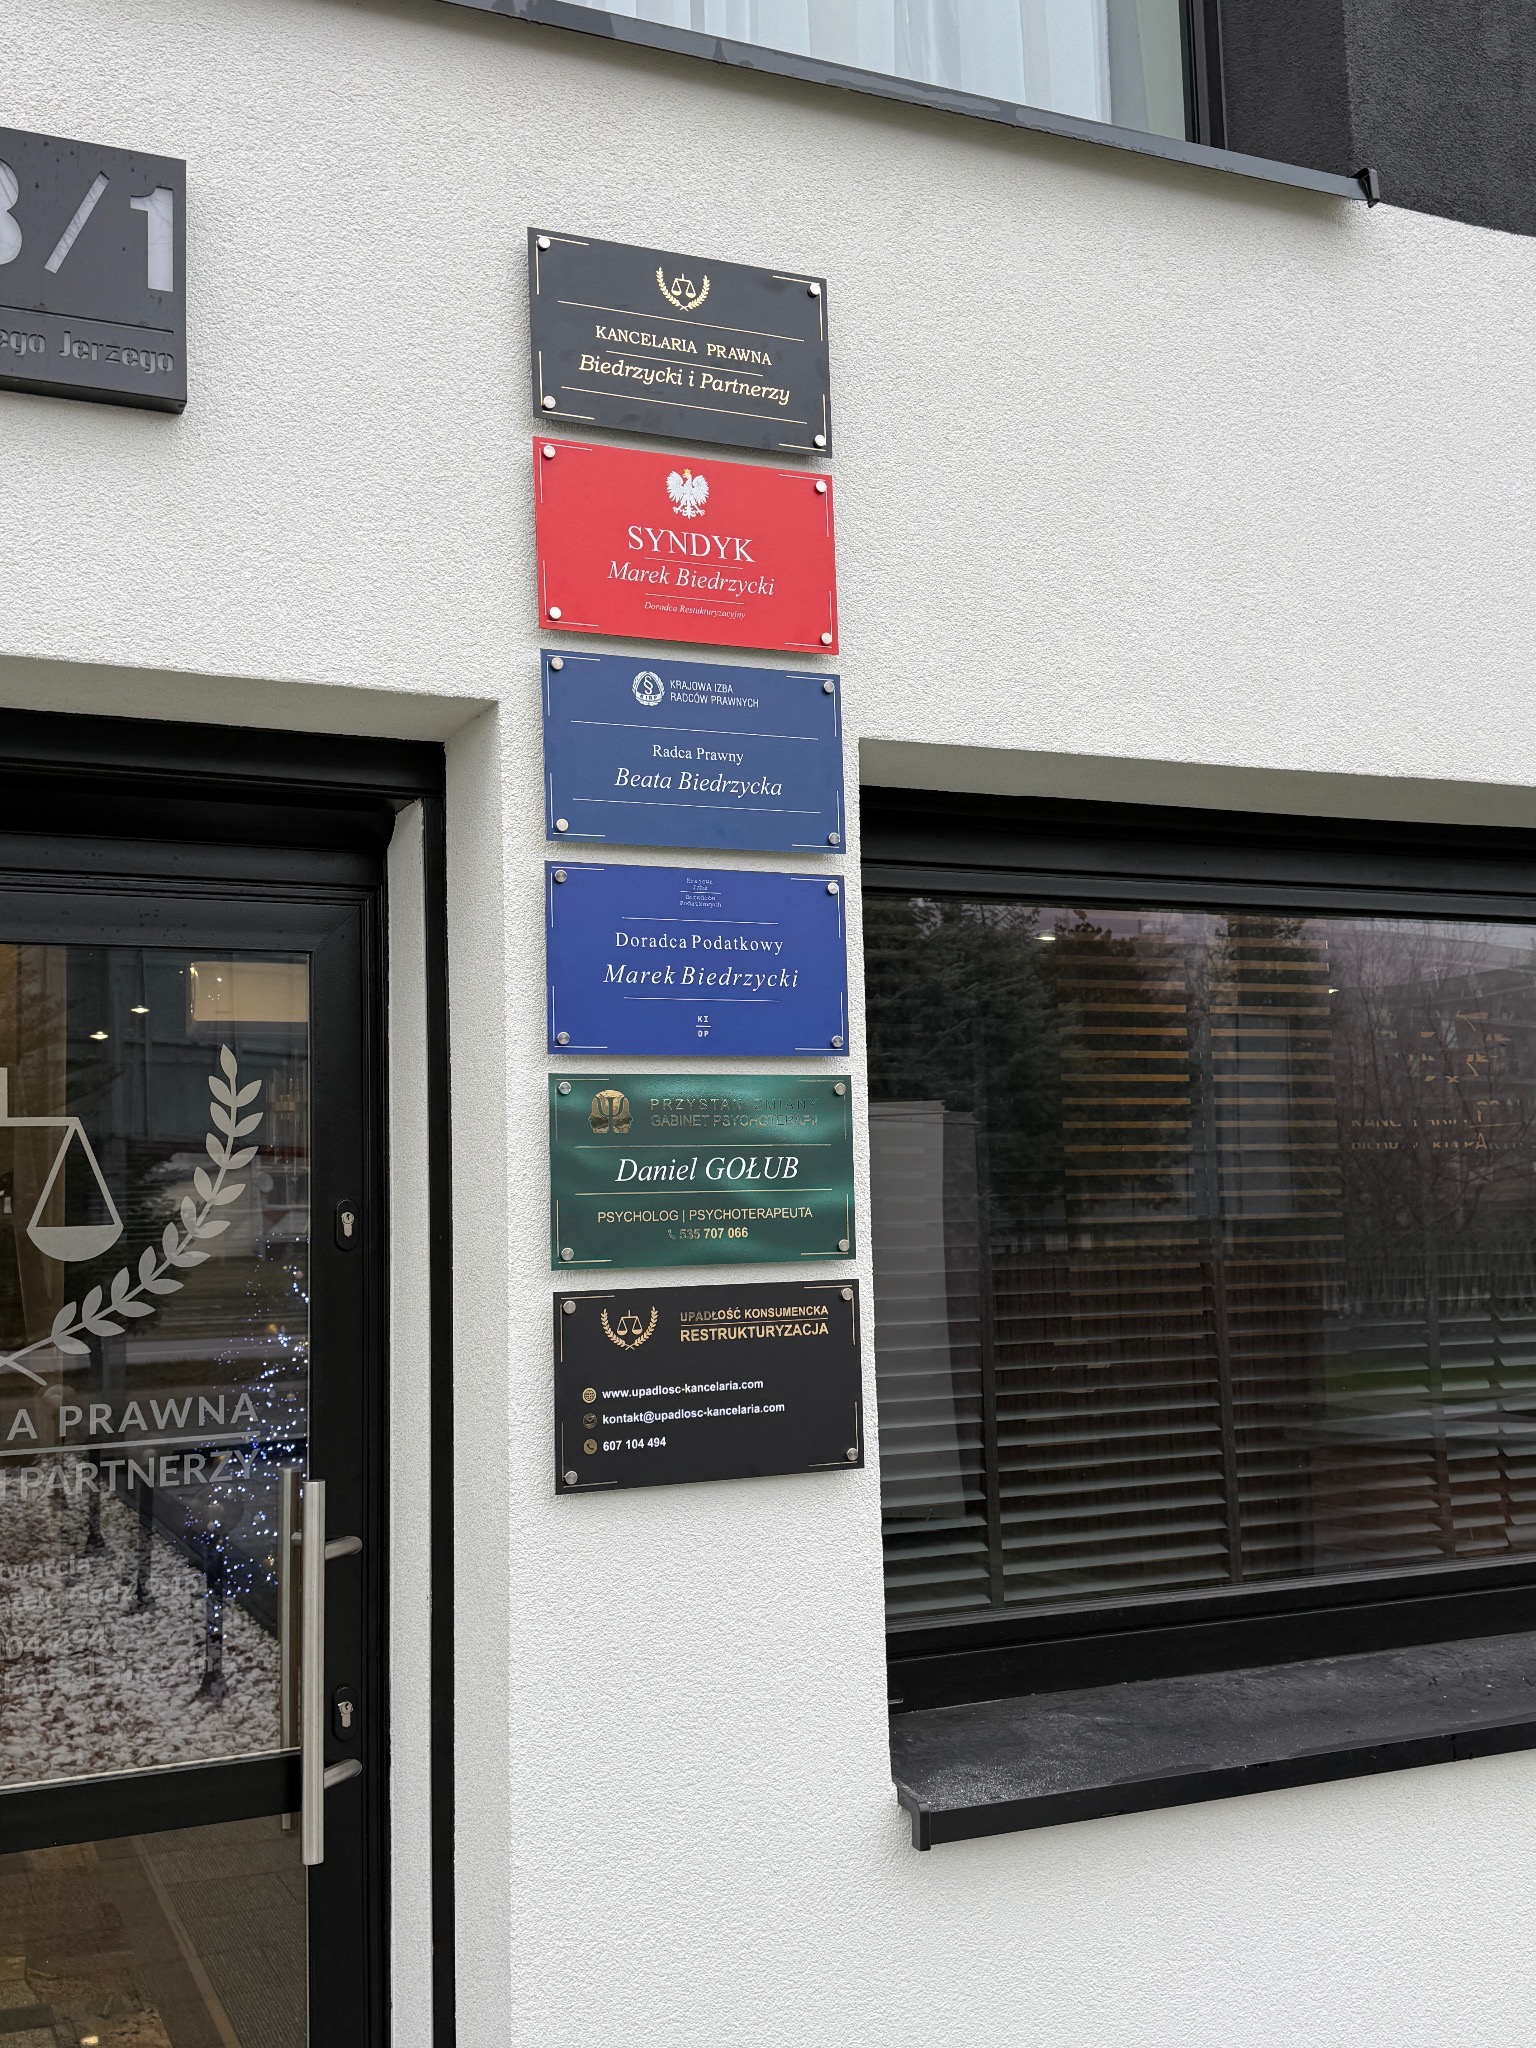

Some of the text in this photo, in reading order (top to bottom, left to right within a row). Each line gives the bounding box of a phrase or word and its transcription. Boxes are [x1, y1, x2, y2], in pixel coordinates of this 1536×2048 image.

[59, 331, 174, 374] Jerzego
[595, 325, 772, 366] KANCELARIA PRAWNA
[579, 354, 791, 406] Biedrzycki i Partnerzy
[628, 525, 756, 563] SYNDYK
[607, 560, 775, 597] Marek Biedrzycki
[644, 601, 678, 612] Doradca
[670, 680, 733, 694] KRAJOWA IZBA
[670, 692, 759, 708] RADCÓW PRAWNYCH
[652, 744, 744, 765] Radca Prawny
[615, 767, 782, 799] Beata Biedrzycka
[615, 932, 784, 955] Doradca Podatkowy
[603, 964, 799, 992] Marek Biedrzycki
[697, 1015, 709, 1023] KI
[753, 1098, 818, 1112] ZMIANY
[651, 1114, 709, 1128] GABINET
[615, 1156, 799, 1182] Daniel GOŁUB
[597, 1209, 679, 1223] PSYCHOLOG
[689, 1207, 813, 1221] PSYCHOTERAPEUTA
[679, 1227, 749, 1240] 535 707 066
[680, 1305, 829, 1322] UPADŁOŚĆ KONSUMENCKA
[680, 1322, 829, 1342] RESTRUKTURYZACJA
[602, 1378, 764, 1400] www.upadlosc-kancelaria.com
[59, 1392, 259, 1437] PRAWNA
[602, 1402, 785, 1426] kontakt@upadlosc-kancelaria.com
[602, 1436, 667, 1452] 607 104 494
[20, 1449, 260, 1500] PARTNERZY
